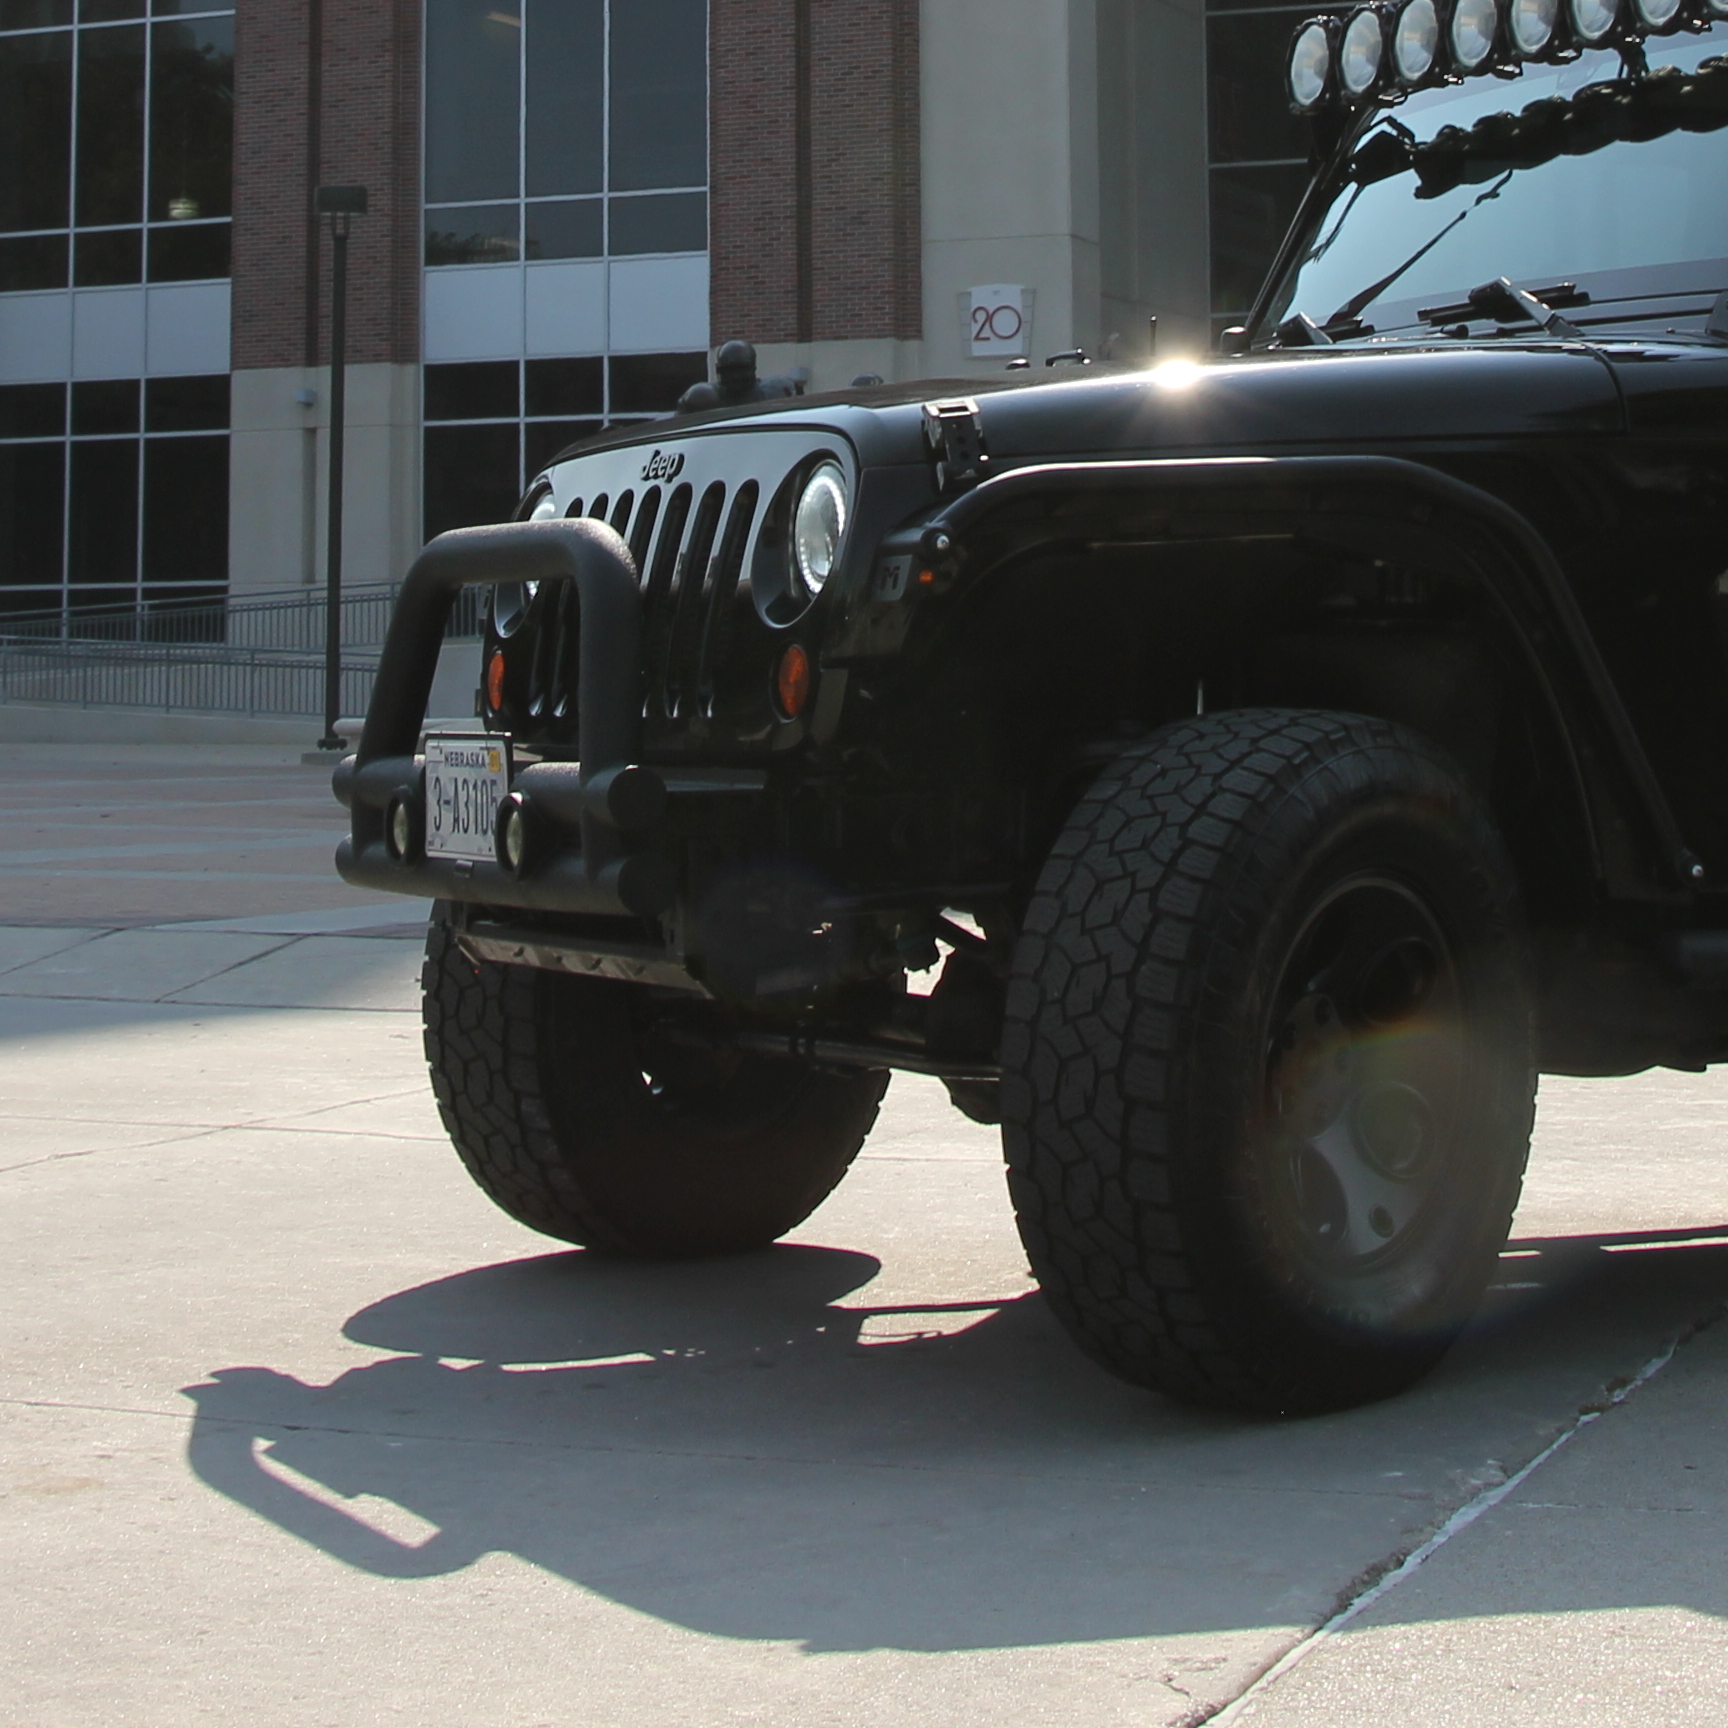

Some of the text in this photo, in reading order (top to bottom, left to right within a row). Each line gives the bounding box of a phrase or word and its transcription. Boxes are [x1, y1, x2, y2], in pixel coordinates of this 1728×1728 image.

[972, 304, 1022, 341] 20
[641, 450, 684, 483] Jeep
[443, 751, 486, 769] NEBRASKA
